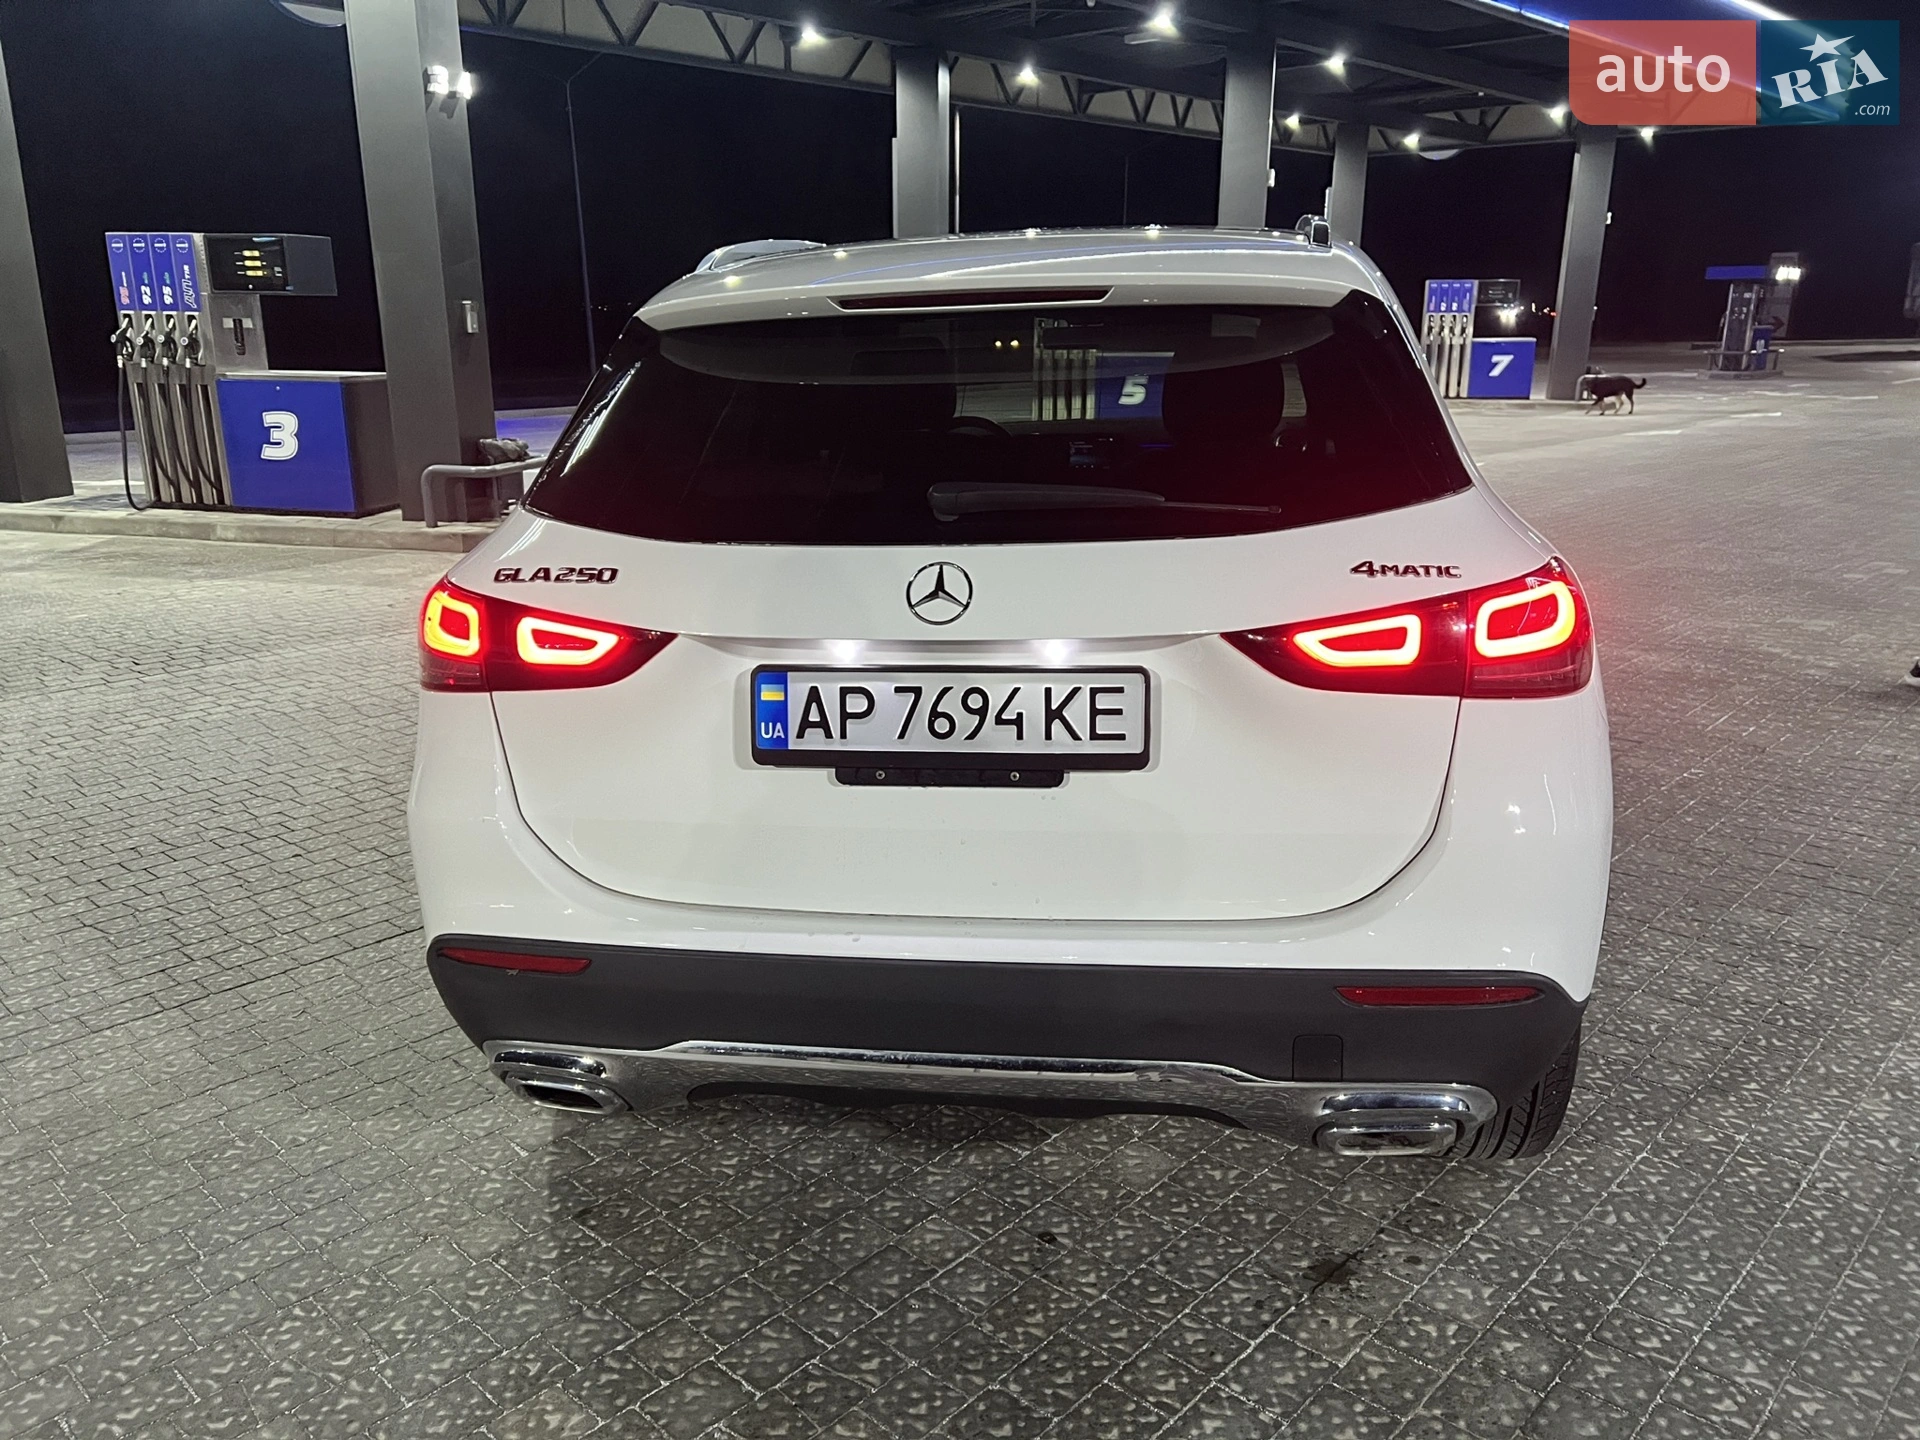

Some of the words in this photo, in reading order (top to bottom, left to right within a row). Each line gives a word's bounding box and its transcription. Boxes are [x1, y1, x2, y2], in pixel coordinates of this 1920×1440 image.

[140, 285, 152, 305] 92
[162, 285, 174, 305] 95
[1488, 354, 1515, 377] 7
[1118, 375, 1149, 405] 5
[260, 410, 299, 460] 3
[1350, 560, 1462, 578] 4MATIC
[795, 685, 876, 740] AP
[893, 686, 1024, 741] 7694
[1044, 686, 1127, 741] KE
[761, 722, 785, 739] UA
